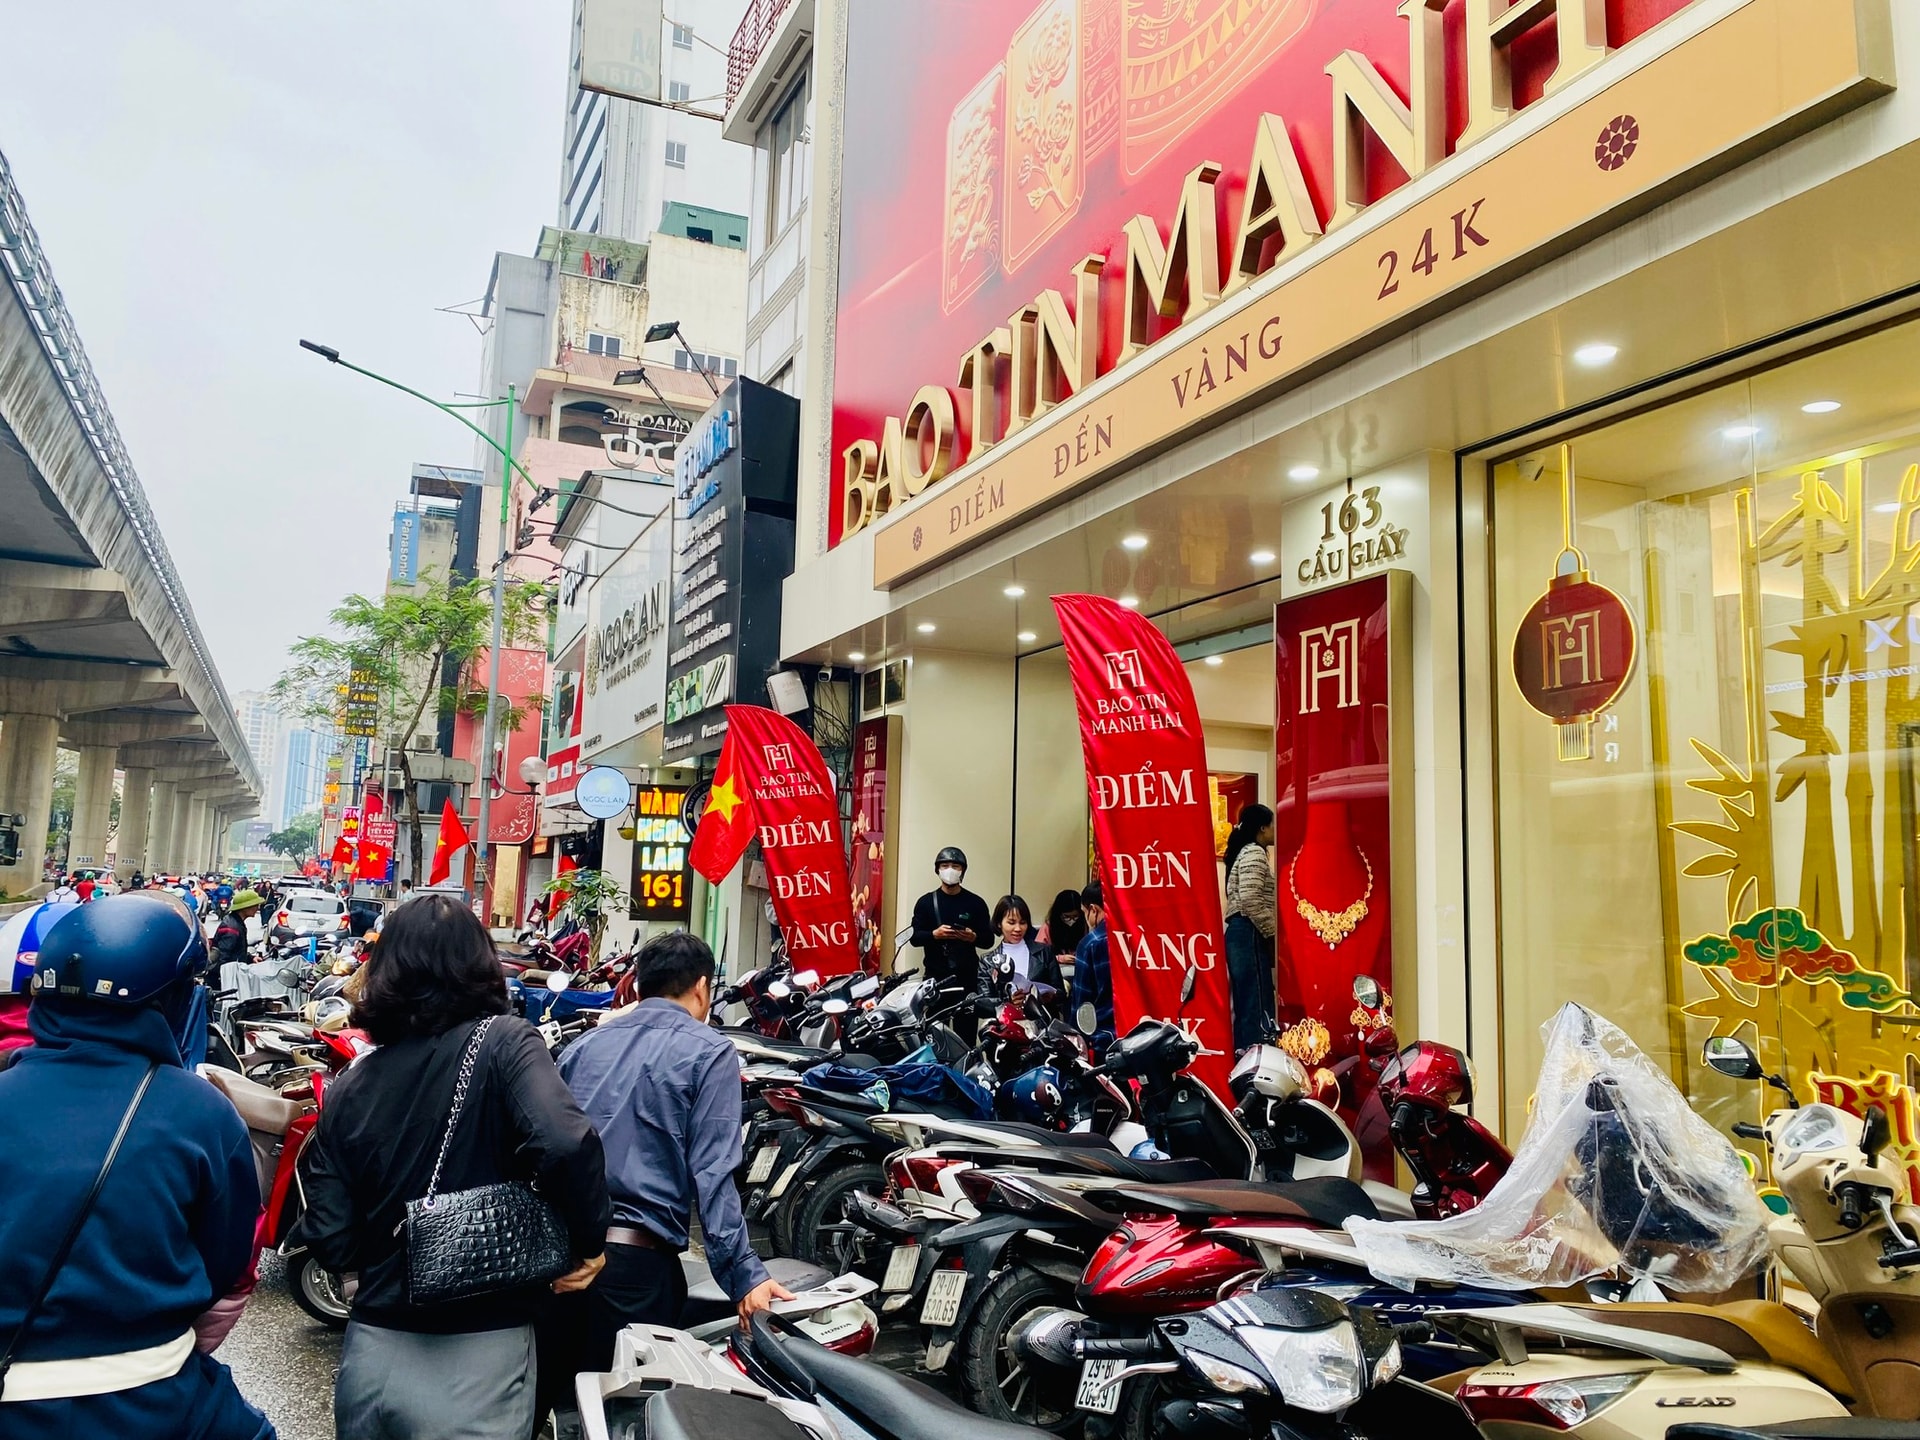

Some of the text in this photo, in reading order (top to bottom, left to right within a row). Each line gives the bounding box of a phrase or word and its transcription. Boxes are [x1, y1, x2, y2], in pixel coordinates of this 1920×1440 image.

[948, 197, 1490, 536] ĐIỂM ĐẾN VÀNG 24K
[842, 384, 955, 540] BAO
[957, 253, 1106, 464] TIN
[1320, 486, 1383, 542] 163
[399, 518, 413, 579] Panasonic
[1297, 522, 1411, 583] CẦU GIẤY
[1096, 693, 1168, 715] BAO TIN
[1091, 712, 1184, 736] MANH HAI
[755, 788, 795, 800] MANH
[760, 771, 811, 787] BAO TIN
[1094, 760, 1198, 810] ĐIỂM
[343, 808, 360, 818] PIN
[758, 814, 834, 848] ĐIỂM
[641, 846, 685, 872] LAN
[1112, 840, 1191, 889] ĐẾN
[774, 865, 832, 900] ĐẾN
[779, 920, 850, 950] VÀNG
[1112, 924, 1217, 972] VÀNG
[1655, 1397, 1737, 1409] LEAD
